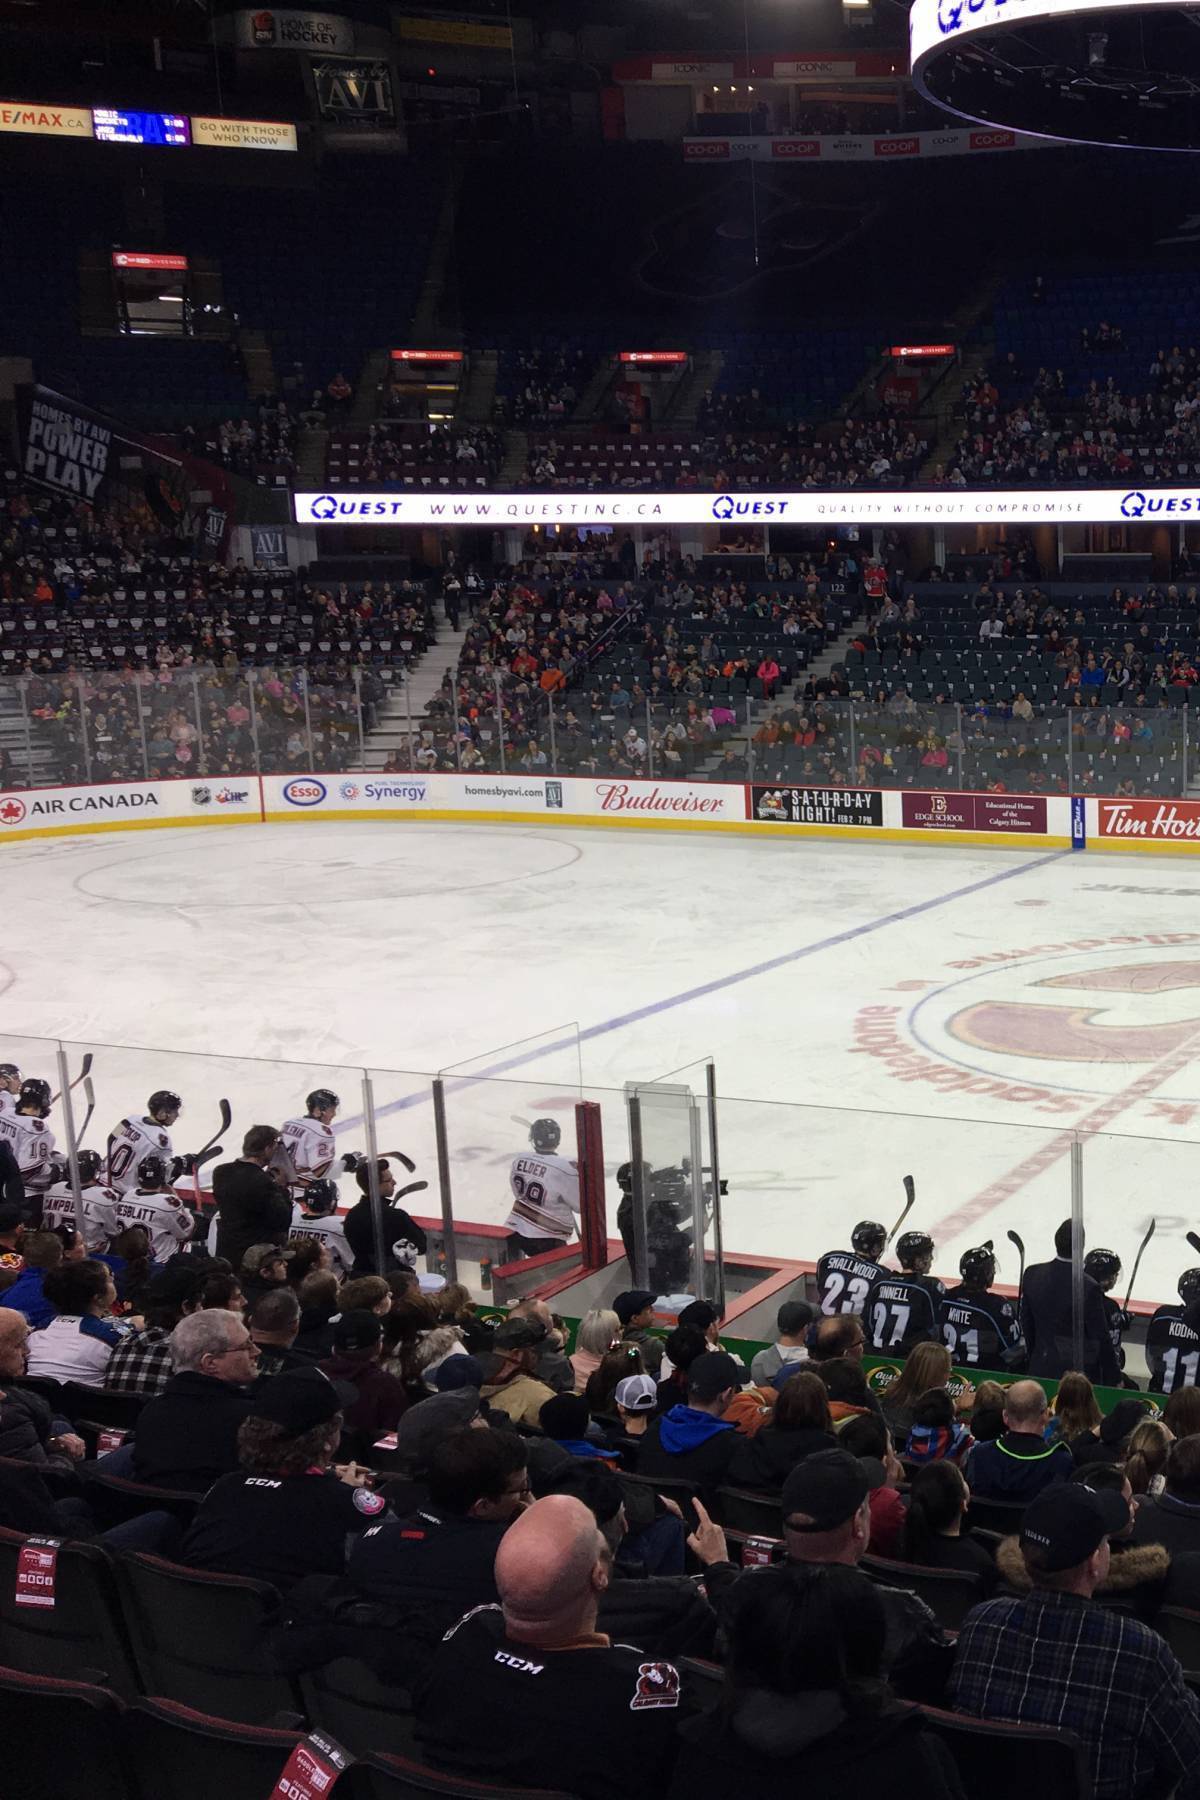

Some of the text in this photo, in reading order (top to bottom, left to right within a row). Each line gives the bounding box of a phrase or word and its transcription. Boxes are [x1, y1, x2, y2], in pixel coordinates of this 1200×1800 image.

[280, 20, 333, 33] HOME OF
[281, 30, 337, 45] HOCKEY
[795, 62, 832, 73] ICONIC
[325, 79, 388, 110] AVI
[200, 122, 289, 137] GO WITH THOSE
[212, 133, 279, 145] WHO KNOW
[687, 143, 725, 156] CO-OP
[777, 143, 815, 154] CO-OP
[879, 141, 915, 154] CO-OP
[973, 134, 1012, 147] CO-OP
[28, 417, 110, 473] POWER
[25, 446, 104, 500] PLAY
[311, 495, 402, 519] QUEST
[711, 495, 790, 519] QUEST
[817, 502, 882, 514] QUALITY
[893, 503, 966, 514] WITHOUT
[975, 502, 1084, 513] COMPROMISE
[256, 532, 287, 555] AVI
[290, 785, 321, 798] Esso
[364, 784, 427, 801] Synergy
[465, 785, 544, 799] homesbyavi.com
[596, 783, 724, 813] Budweiser
[30, 790, 159, 816] AIR CANADA
[985, 801, 1035, 810] Educational Home
[792, 805, 836, 823] NIGHT!
[837, 816, 849, 824] FEB
[914, 813, 964, 822] EDGE SCHOOL
[988, 818, 1032, 827] Calgary Hitmen
[1103, 804, 1147, 835] Tim
[848, 1004, 1088, 1114] Saddledome
[516, 1159, 548, 1179] ELDER
[44, 1198, 92, 1217] CAMPBEL
[827, 1256, 877, 1281] SMALLWOOD
[820, 1272, 870, 1316] 23
[873, 1304, 911, 1348] 27
[948, 1309, 972, 1326] WHITE
[943, 1327, 980, 1364] 21
[1161, 1347, 1200, 1395] 11
[244, 1477, 282, 1489] CCM
[494, 1650, 545, 1676] CCM
